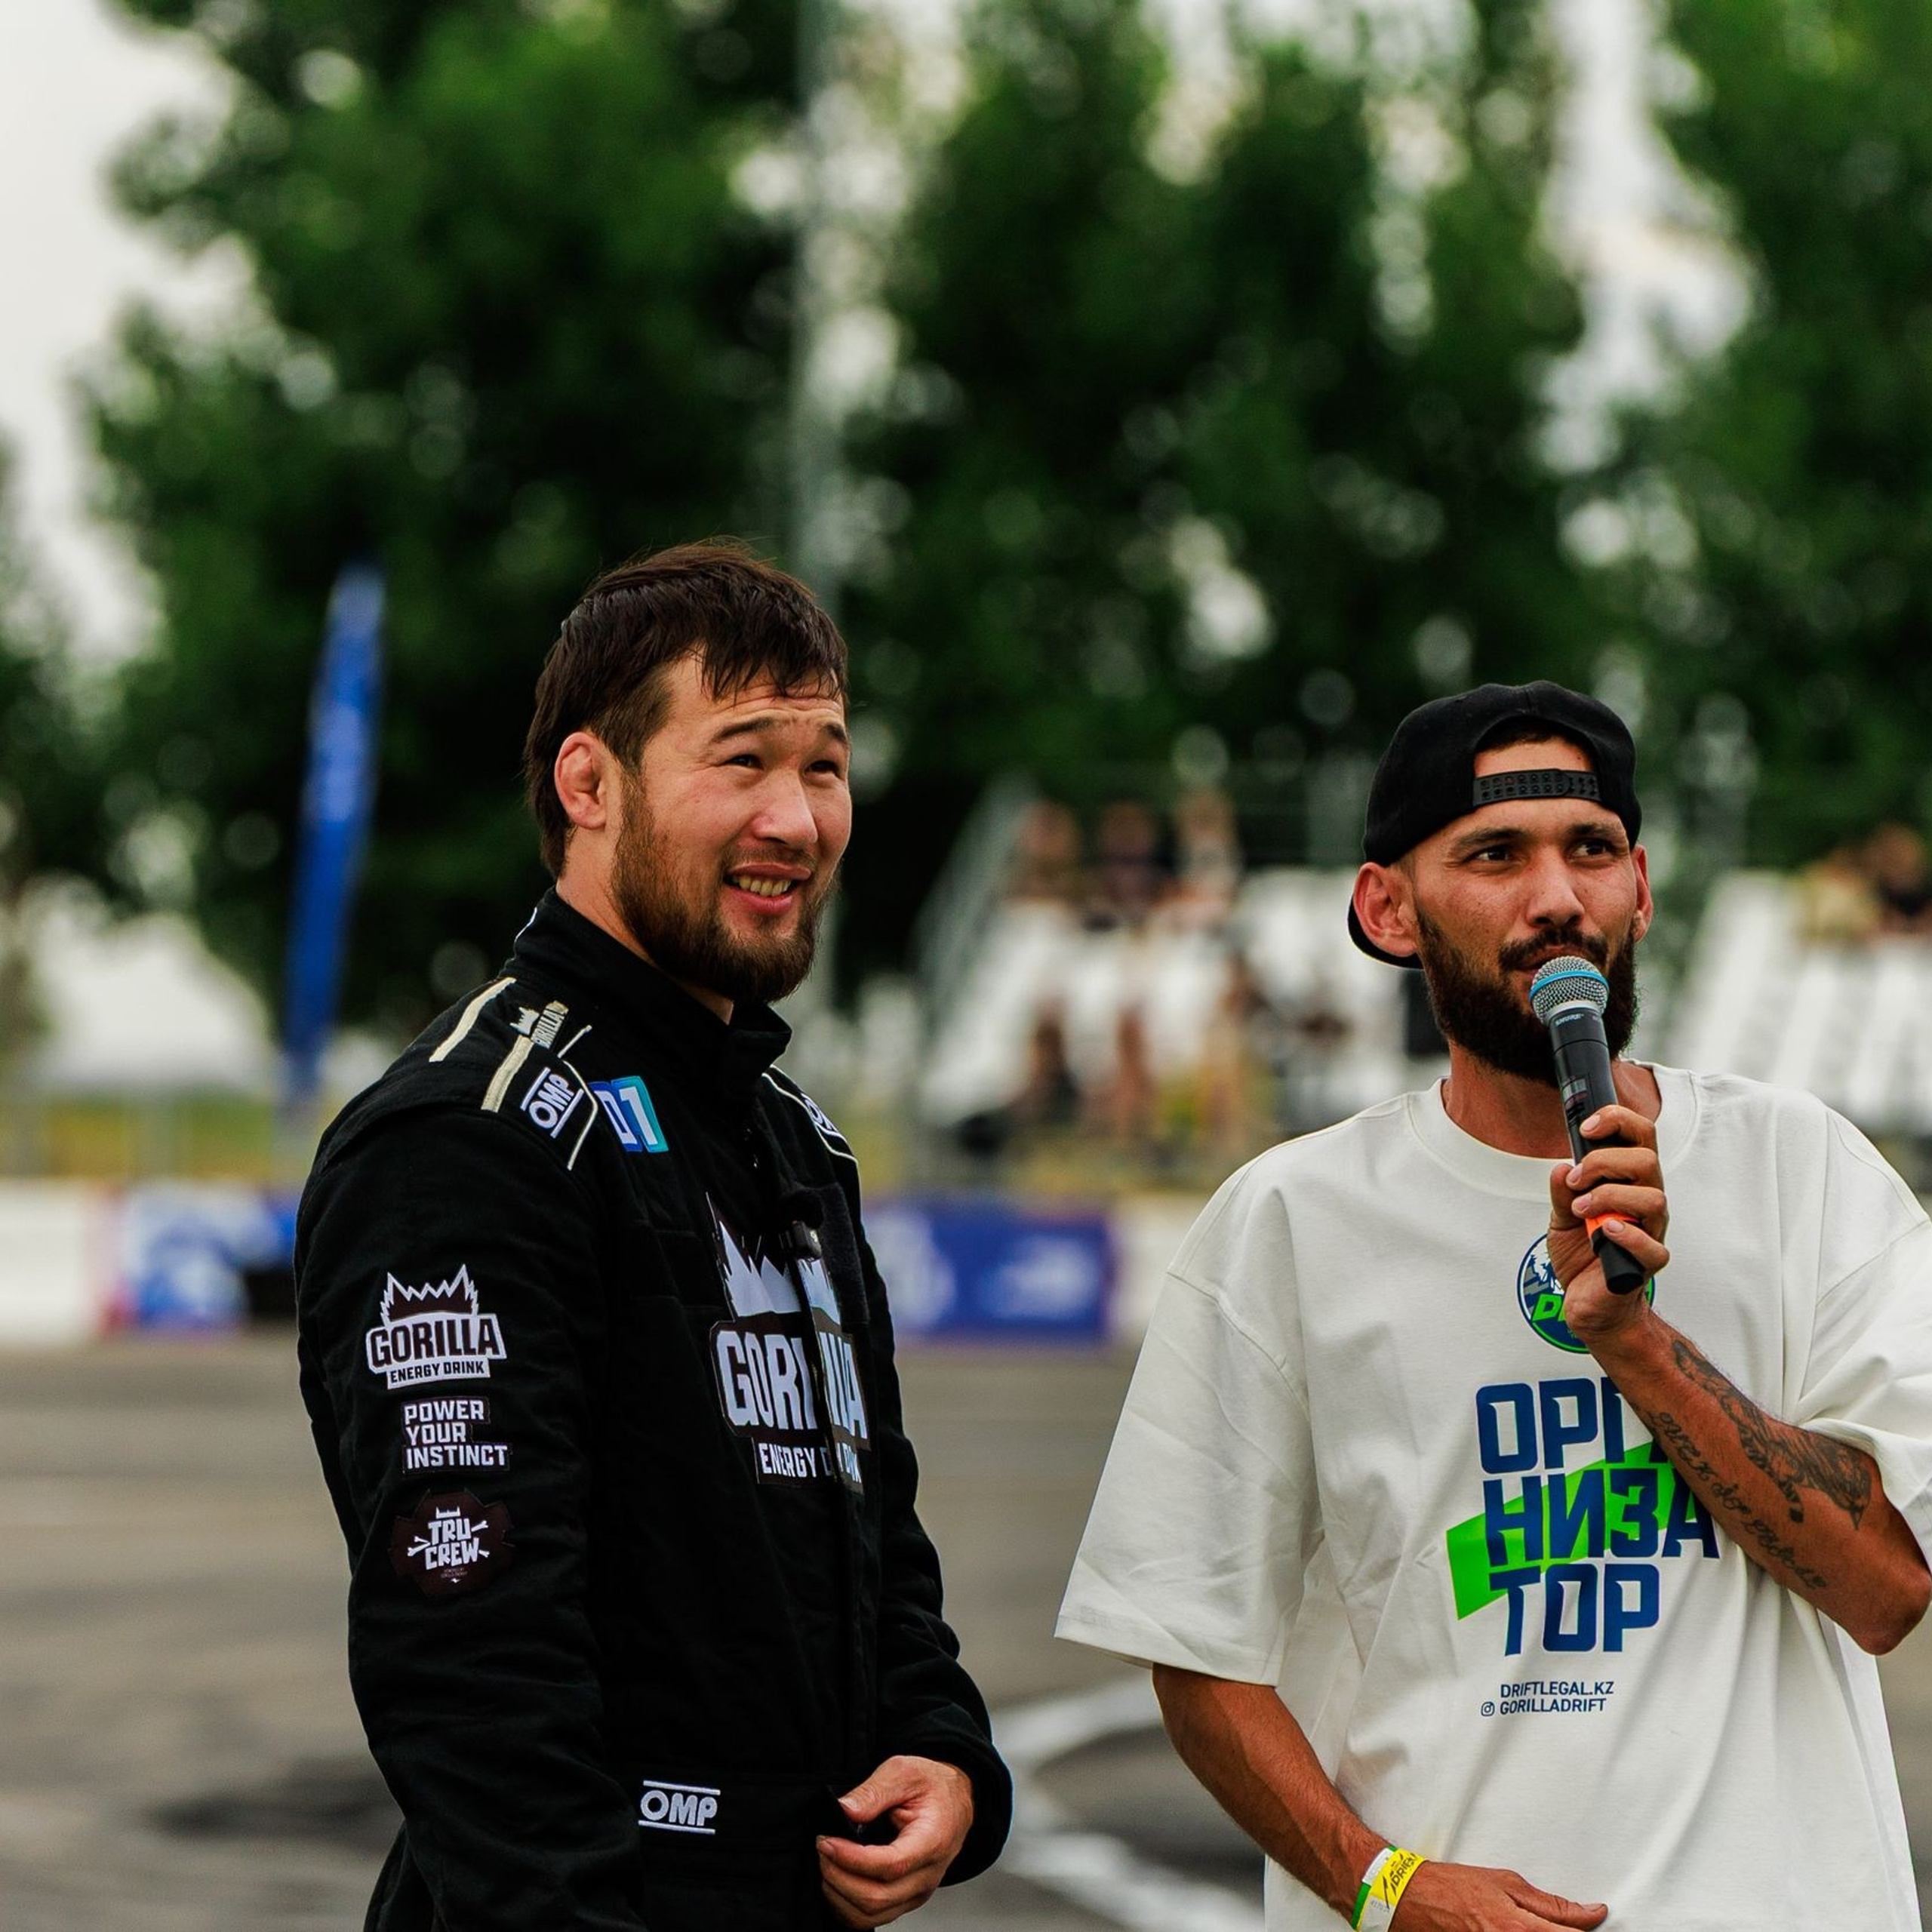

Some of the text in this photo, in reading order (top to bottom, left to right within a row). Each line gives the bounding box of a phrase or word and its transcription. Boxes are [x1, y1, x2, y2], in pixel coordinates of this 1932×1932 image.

[529, 1074, 574, 1129] OMP
[370, 1318, 500, 1368] GORILLA
[390, 1361, 485, 1383] ENERGY DRINK
[404, 1399, 485, 1425] POWER
[1475, 1377, 1669, 1474] ОРГ
[405, 1422, 466, 1446] YOUR
[406, 1444, 508, 1469] INSTINCT
[758, 1443, 817, 1478] ENERGY
[428, 1518, 472, 1546] TRU
[1483, 1468, 1721, 1567] НИЗА
[425, 1537, 479, 1570] CREW
[1489, 1563, 1660, 1657] ТОР
[1500, 1681, 1614, 1698] DRIFTLEGAL.KZ
[1500, 1698, 1607, 1715] GORILLADRIFT
[640, 1789, 718, 1826] OMP
